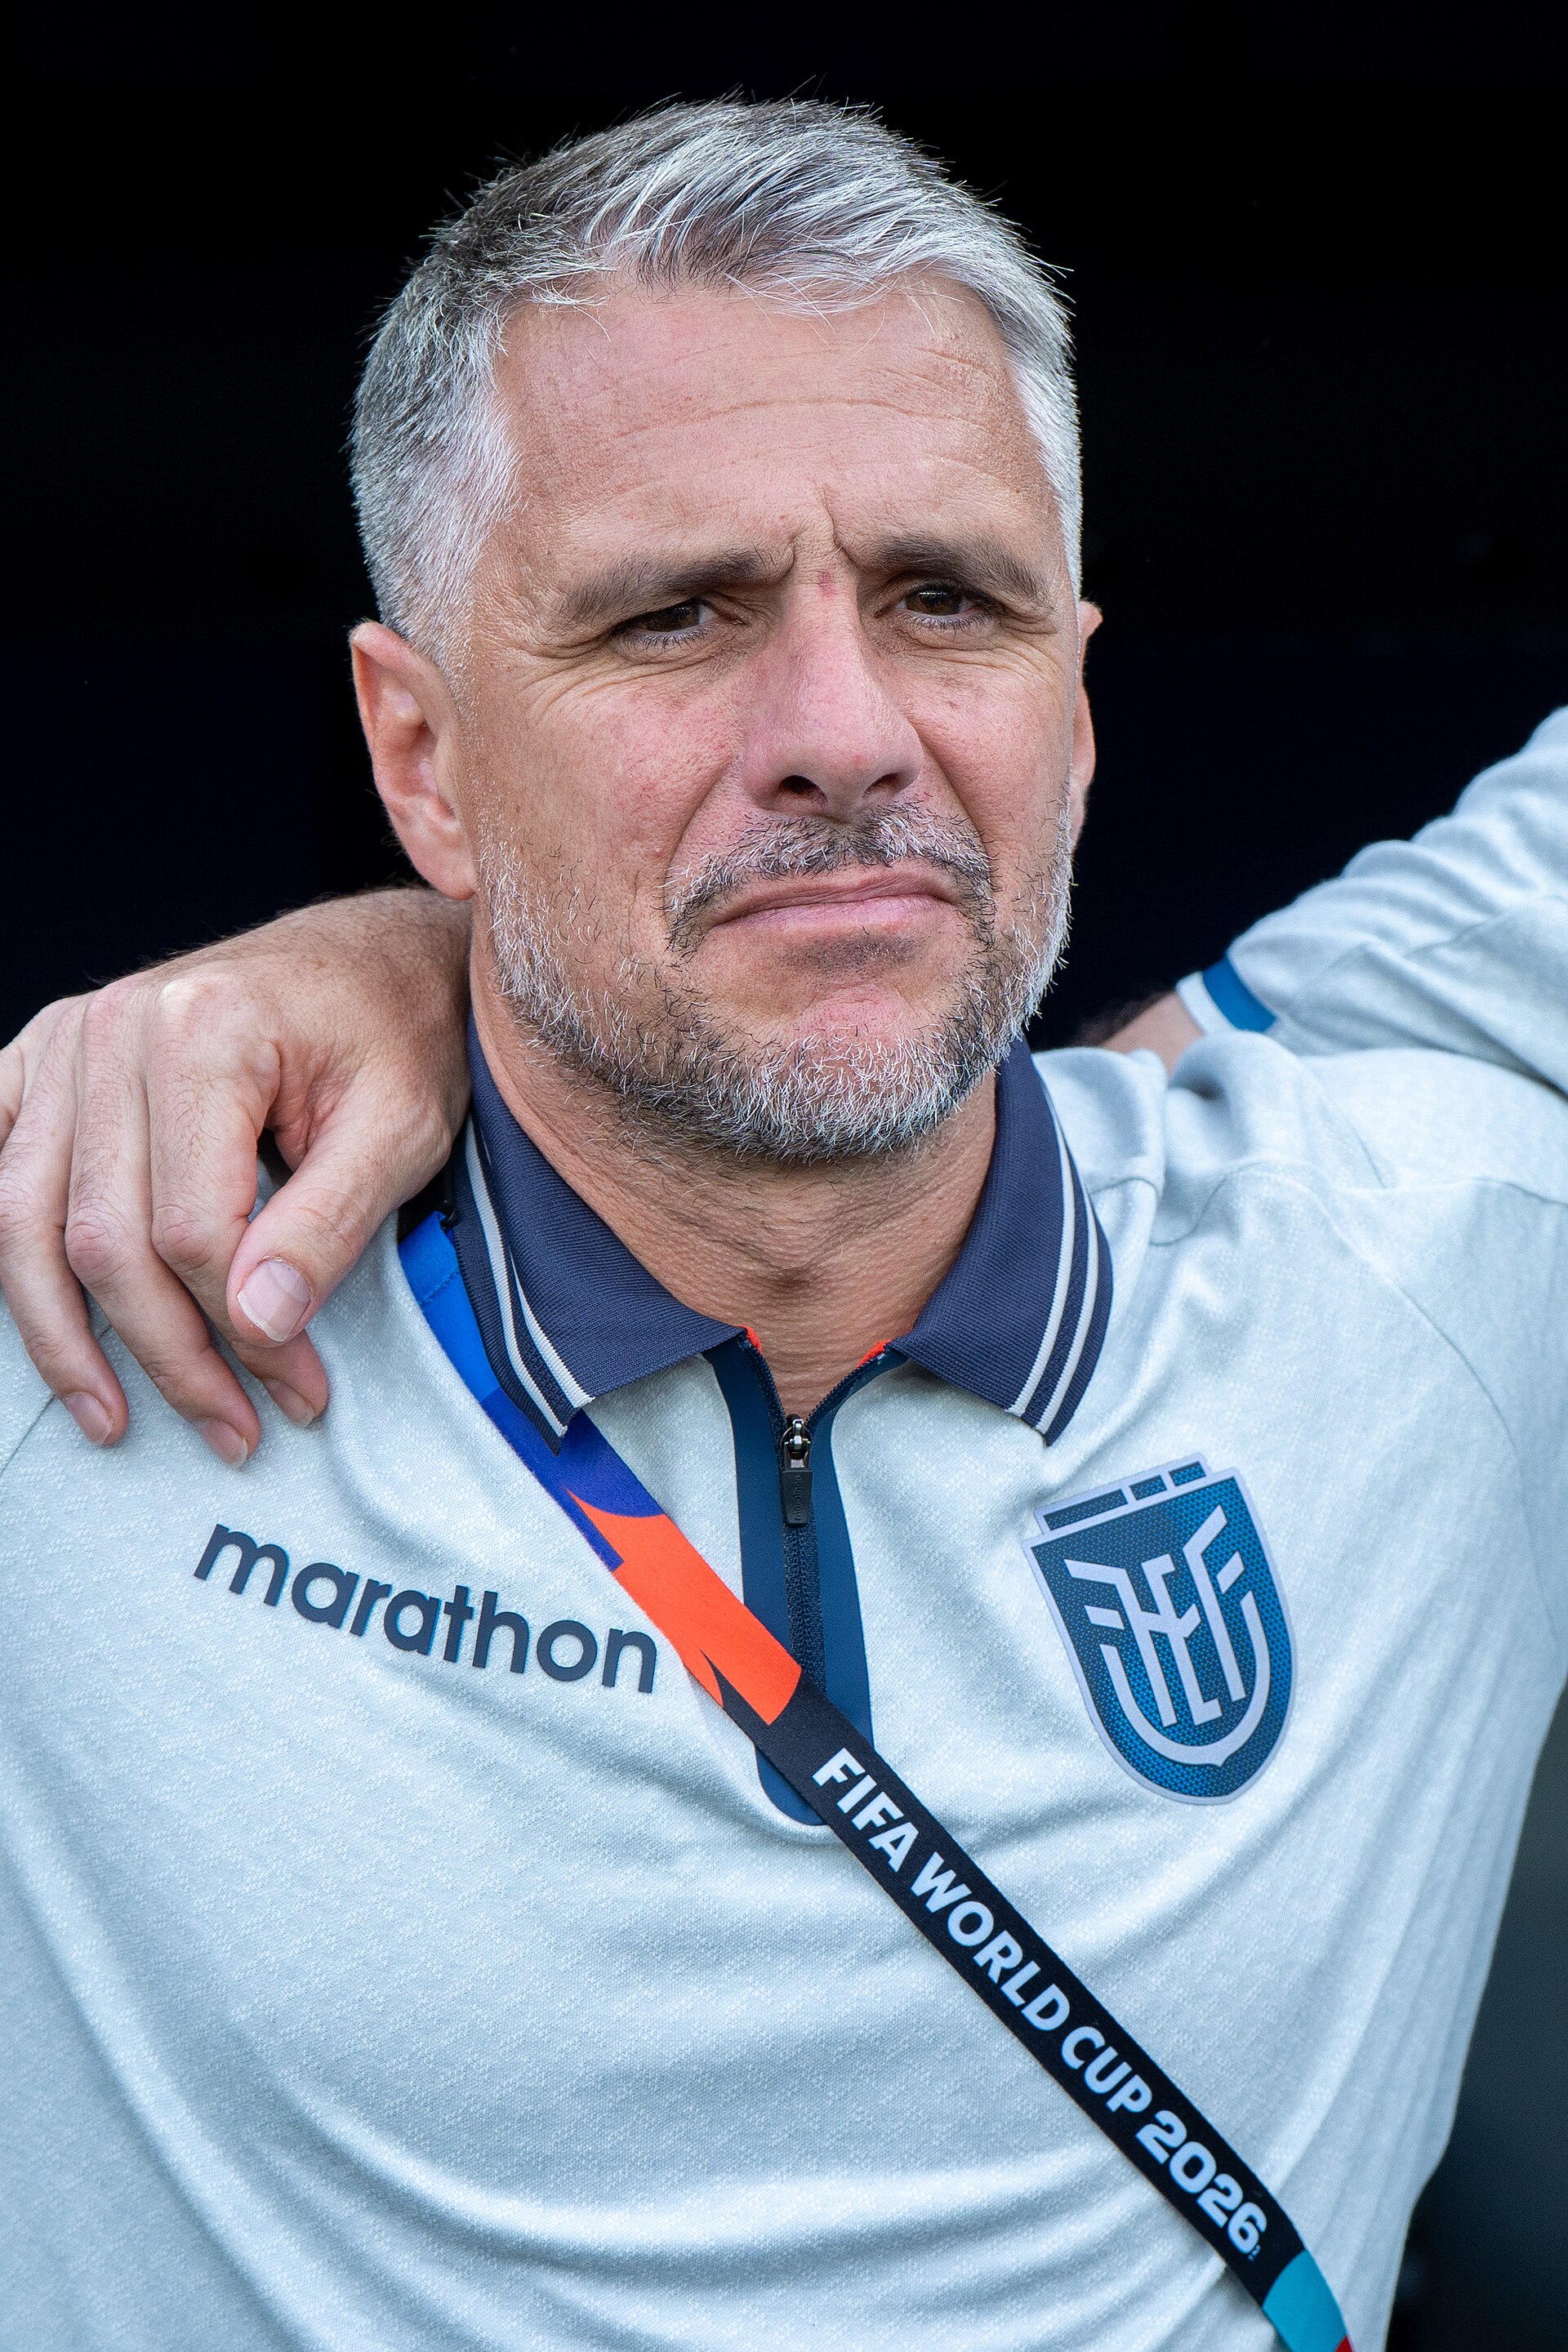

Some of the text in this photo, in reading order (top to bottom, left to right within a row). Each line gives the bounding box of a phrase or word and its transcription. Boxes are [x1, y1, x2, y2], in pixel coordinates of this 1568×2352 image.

[194, 1524, 657, 1693] marathon
[812, 1748, 1267, 2255] FIFA WORLD CUP 2026
